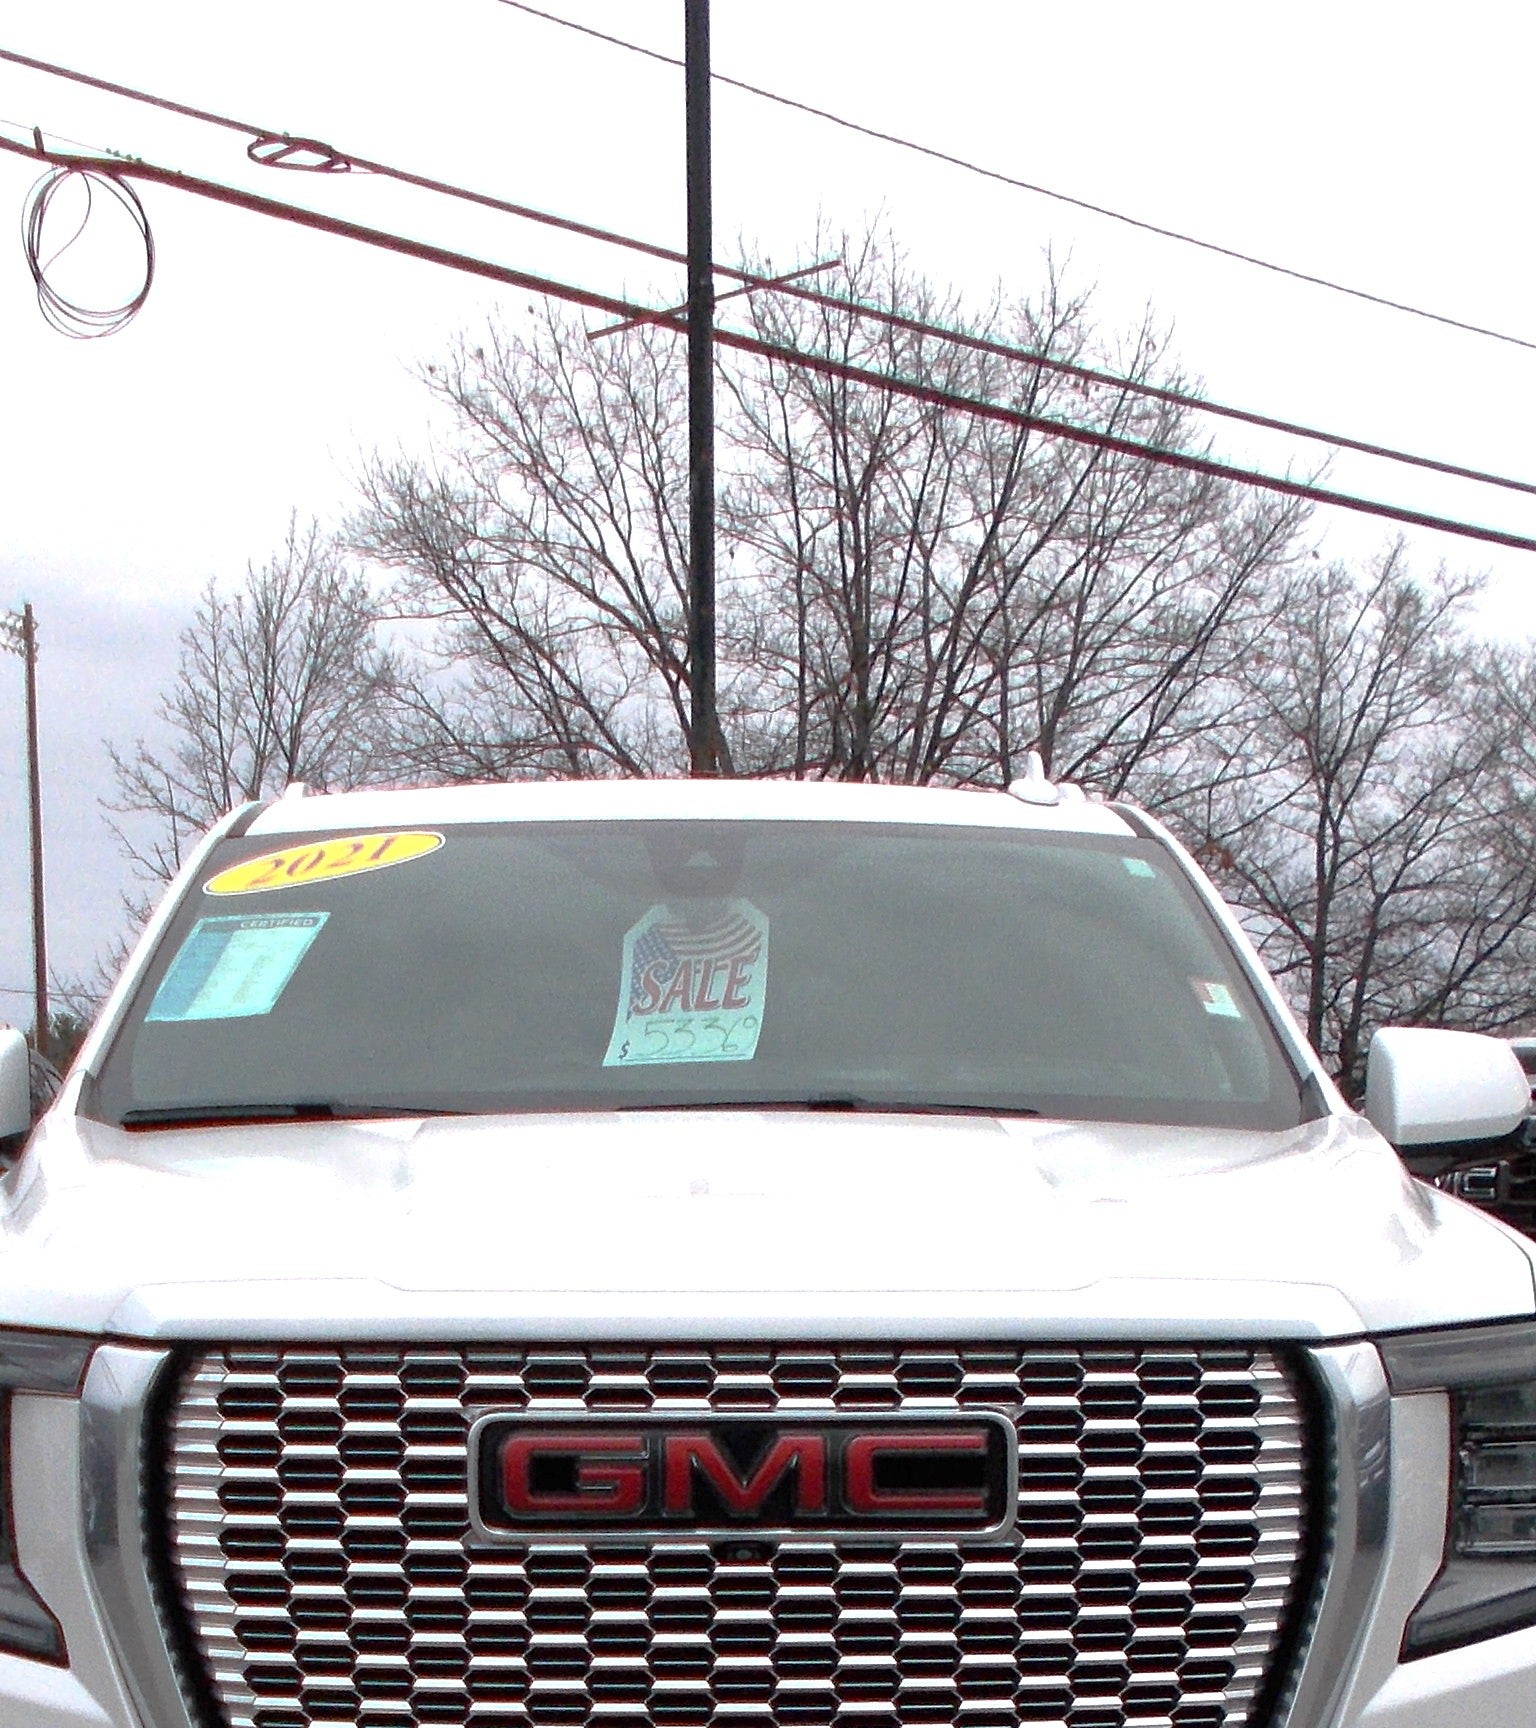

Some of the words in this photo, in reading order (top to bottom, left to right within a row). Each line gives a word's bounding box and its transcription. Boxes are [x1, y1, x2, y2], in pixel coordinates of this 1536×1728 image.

[246, 835, 398, 887] 2021
[240, 917, 314, 929] CERTIFIED
[631, 951, 760, 1017] SALE
[501, 1430, 989, 1518] GMC
